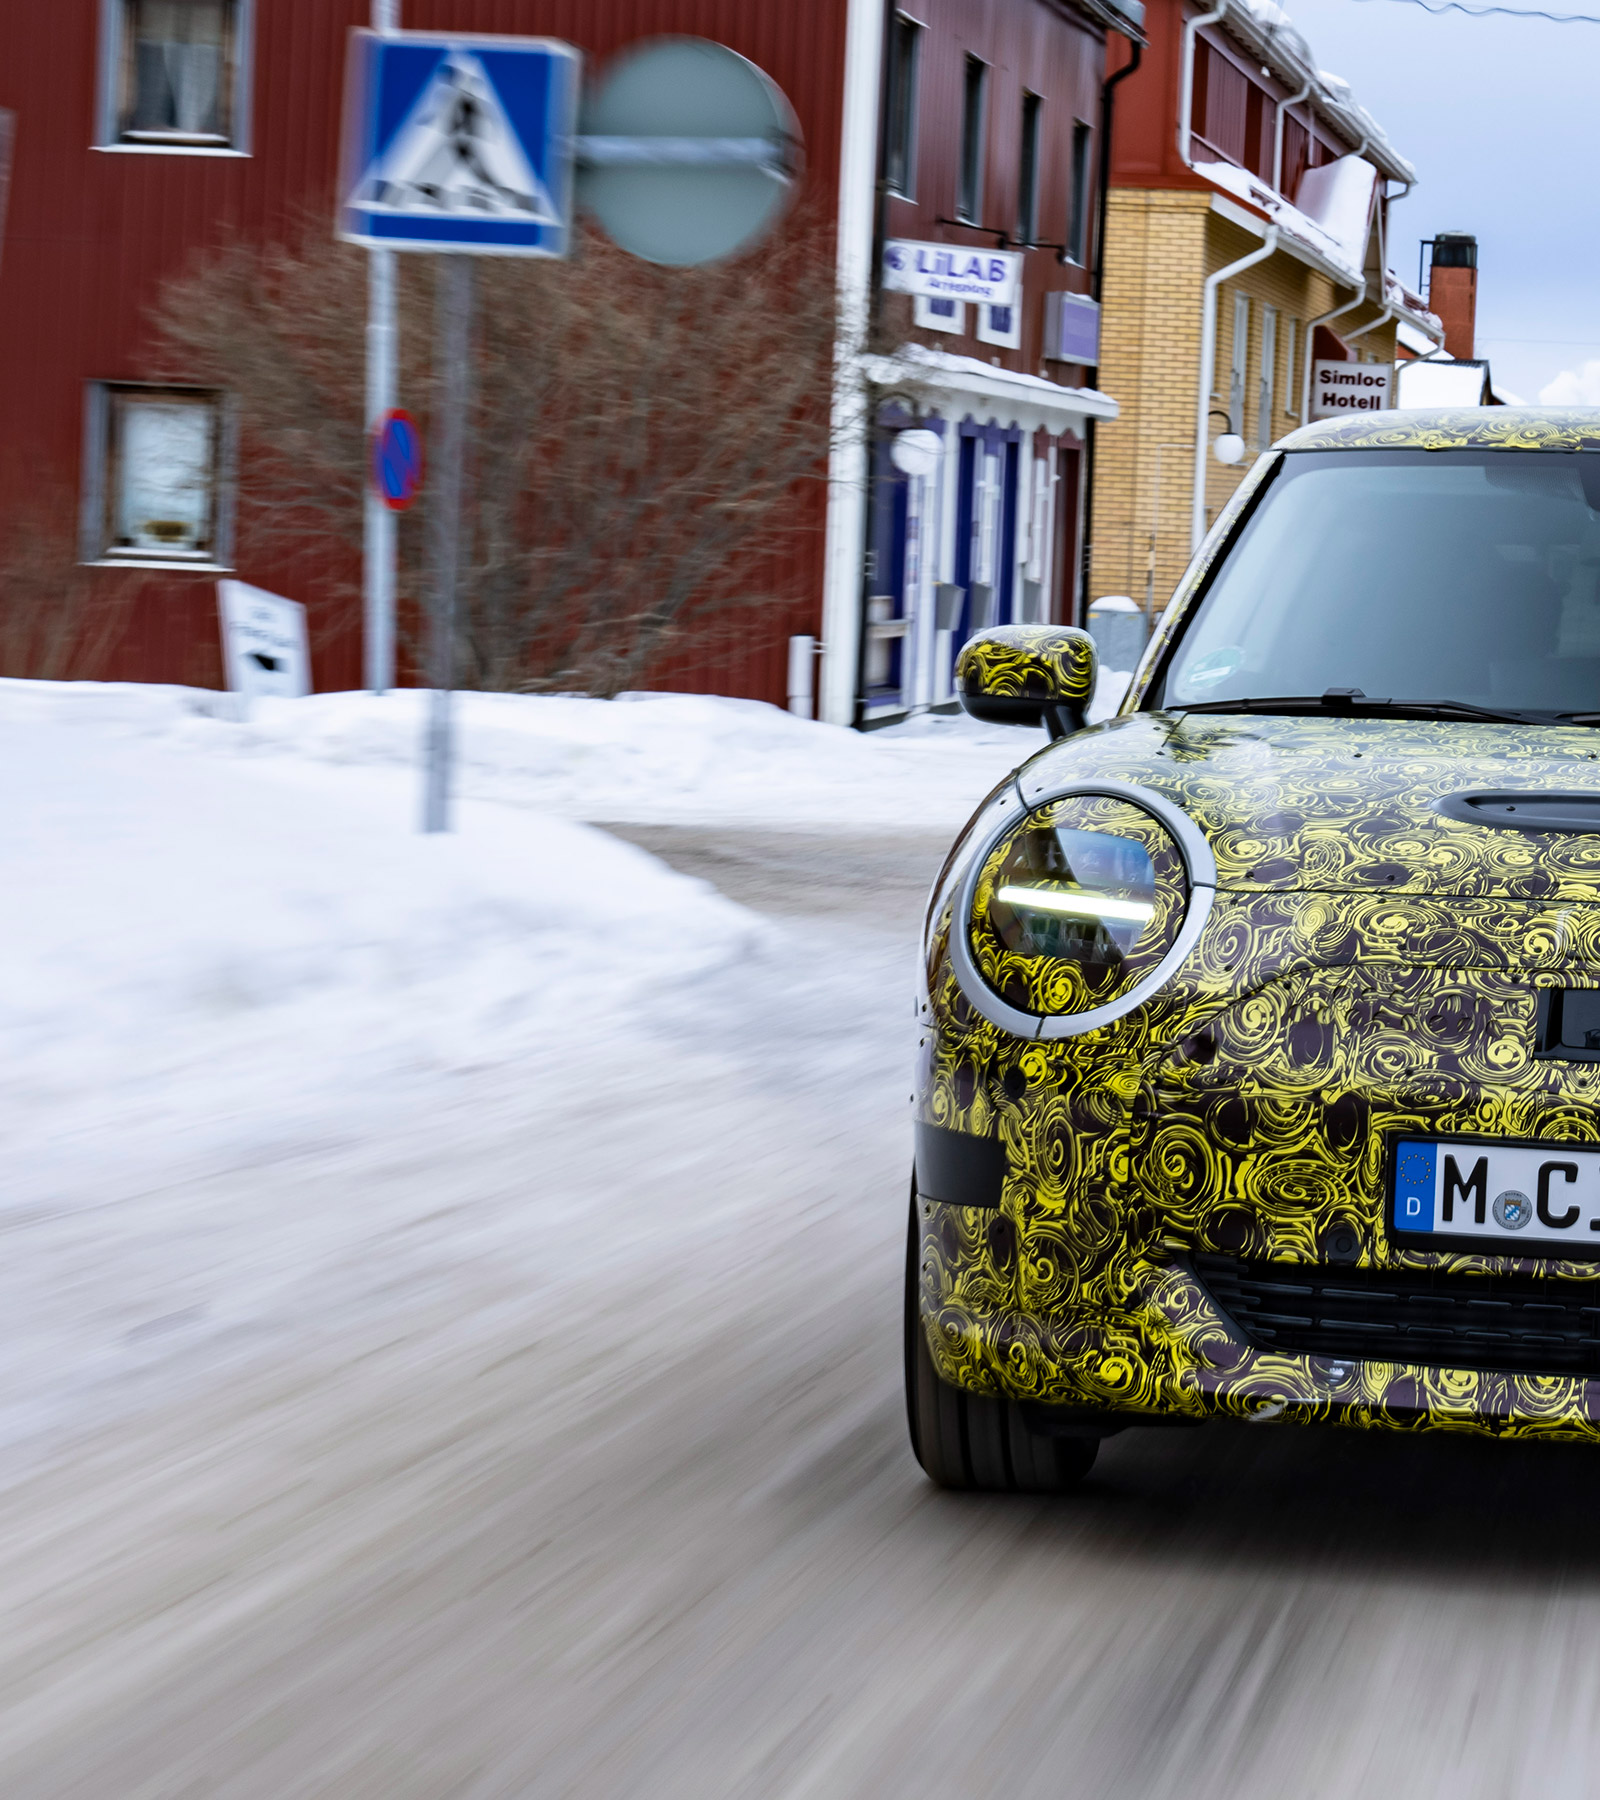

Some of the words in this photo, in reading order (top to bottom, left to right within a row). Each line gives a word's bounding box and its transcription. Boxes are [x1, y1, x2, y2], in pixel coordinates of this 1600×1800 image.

[1319, 369, 1386, 388] Simloc
[1322, 392, 1381, 410] Hotell
[1442, 1153, 1488, 1224] M
[1406, 1197, 1421, 1216] D
